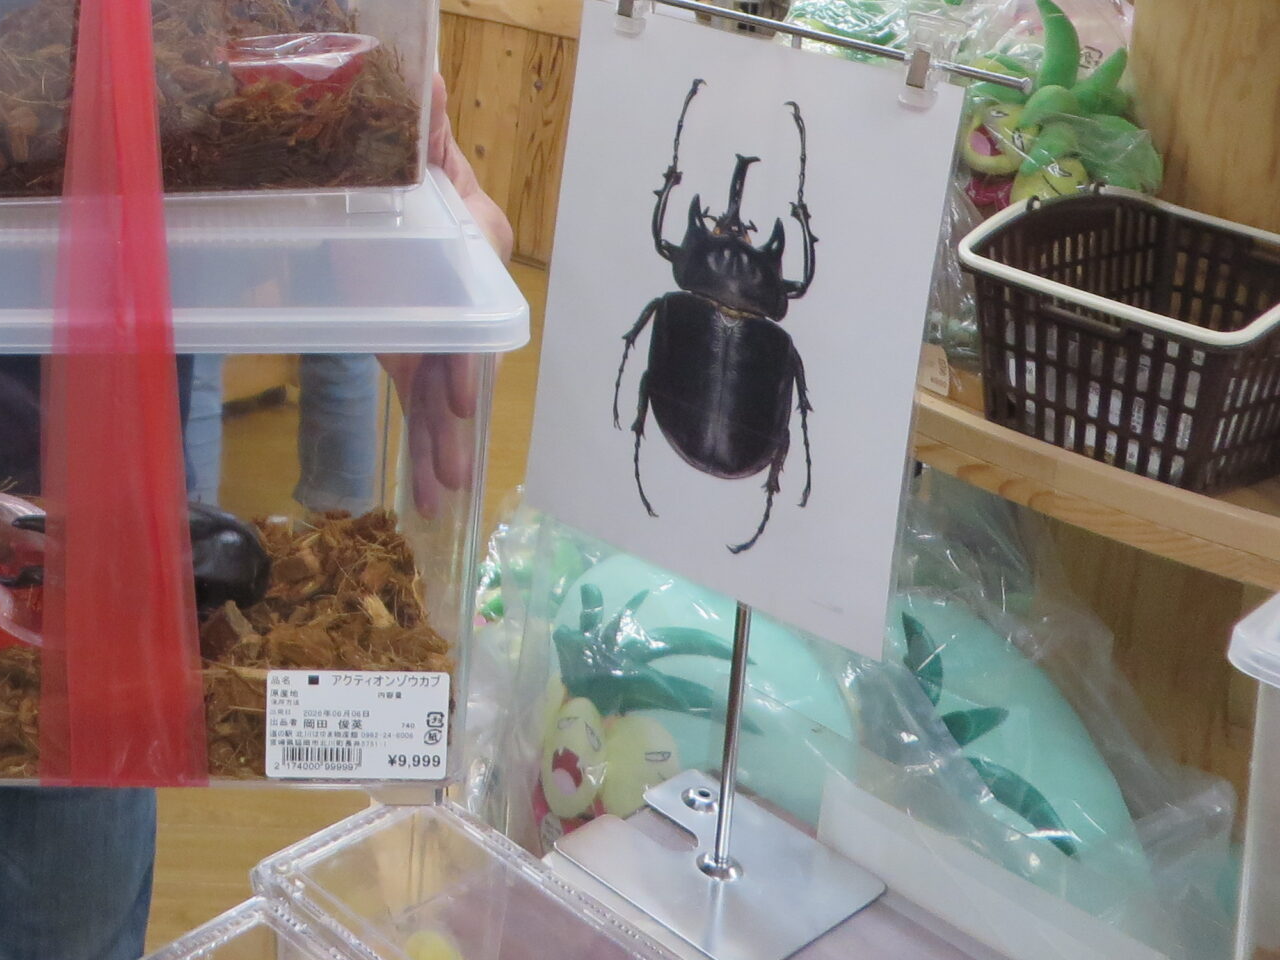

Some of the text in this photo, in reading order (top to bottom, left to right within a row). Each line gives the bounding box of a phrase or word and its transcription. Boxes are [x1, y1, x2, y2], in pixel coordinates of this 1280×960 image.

[270, 675, 442, 687] 品名 アクティオンゾウカブ
[377, 691, 403, 700] 内容量
[303, 719, 328, 729] 岡田
[387, 754, 442, 768] ¥9,999
